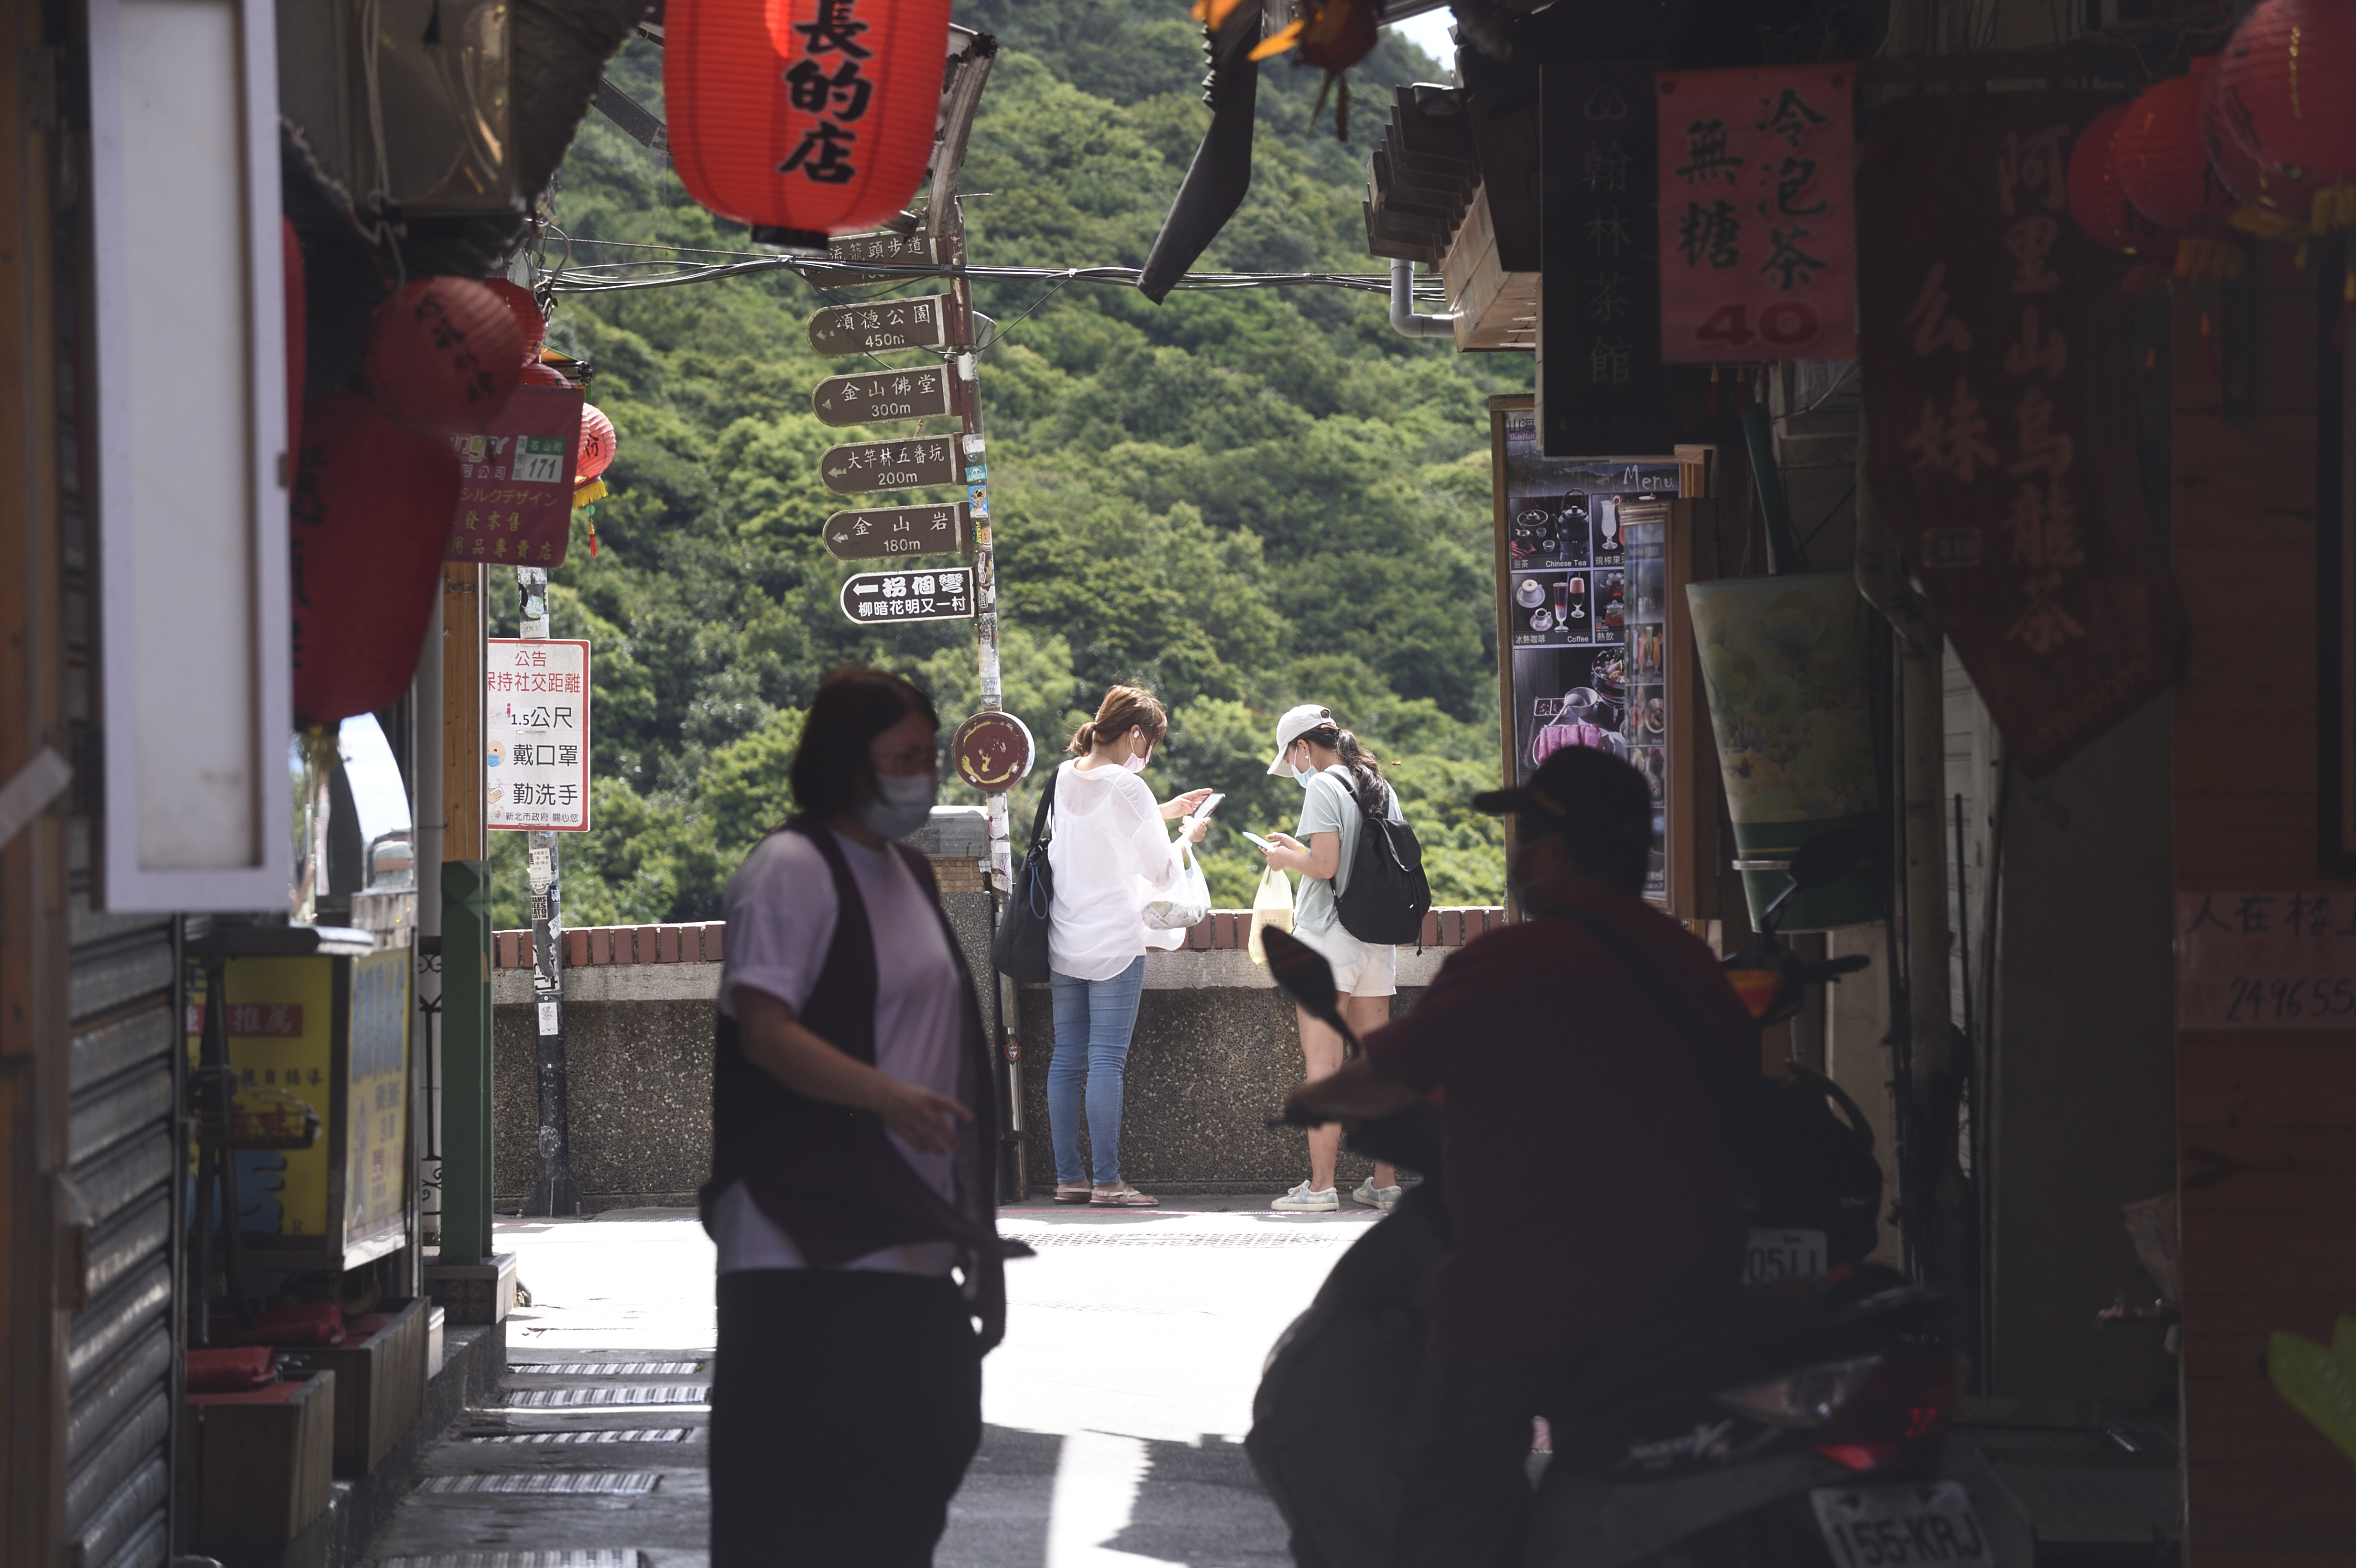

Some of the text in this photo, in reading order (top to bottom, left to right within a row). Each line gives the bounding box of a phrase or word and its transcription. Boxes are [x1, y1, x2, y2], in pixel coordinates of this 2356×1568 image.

[1676, 120, 1745, 270] 無糖
[1756, 87, 1829, 292] 冷泡茶
[1581, 139, 1634, 385] 翰林茶館
[835, 305, 931, 331] 頌德公園
[1695, 303, 1821, 347] 40
[865, 334, 905, 349] 450m
[840, 374, 937, 402] 金山佛堂
[871, 402, 911, 417] 300m
[528, 457, 557, 479] 171
[847, 444, 945, 470] 大竿林五番坑
[878, 470, 918, 486] 200m
[1623, 464, 1674, 491] Menu
[460, 486, 558, 507] シルクデザイン
[852, 512, 949, 537] 金山岩
[884, 537, 921, 553] 180m
[1513, 559, 1529, 568] 泡茶
[1545, 560, 1572, 568] Chinese
[882, 572, 965, 598] 拐個彎
[858, 596, 967, 618] 柳暗花明又一村
[1515, 634, 1546, 644] 冰熱咖啡
[1596, 632, 1614, 642] 熱飲
[515, 650, 546, 667] 公告
[511, 706, 573, 729] 1.5公尺
[513, 743, 578, 766] 戴口罩
[513, 783, 578, 806] 勤洗手
[505, 812, 578, 823] 新北市政府 關心您
